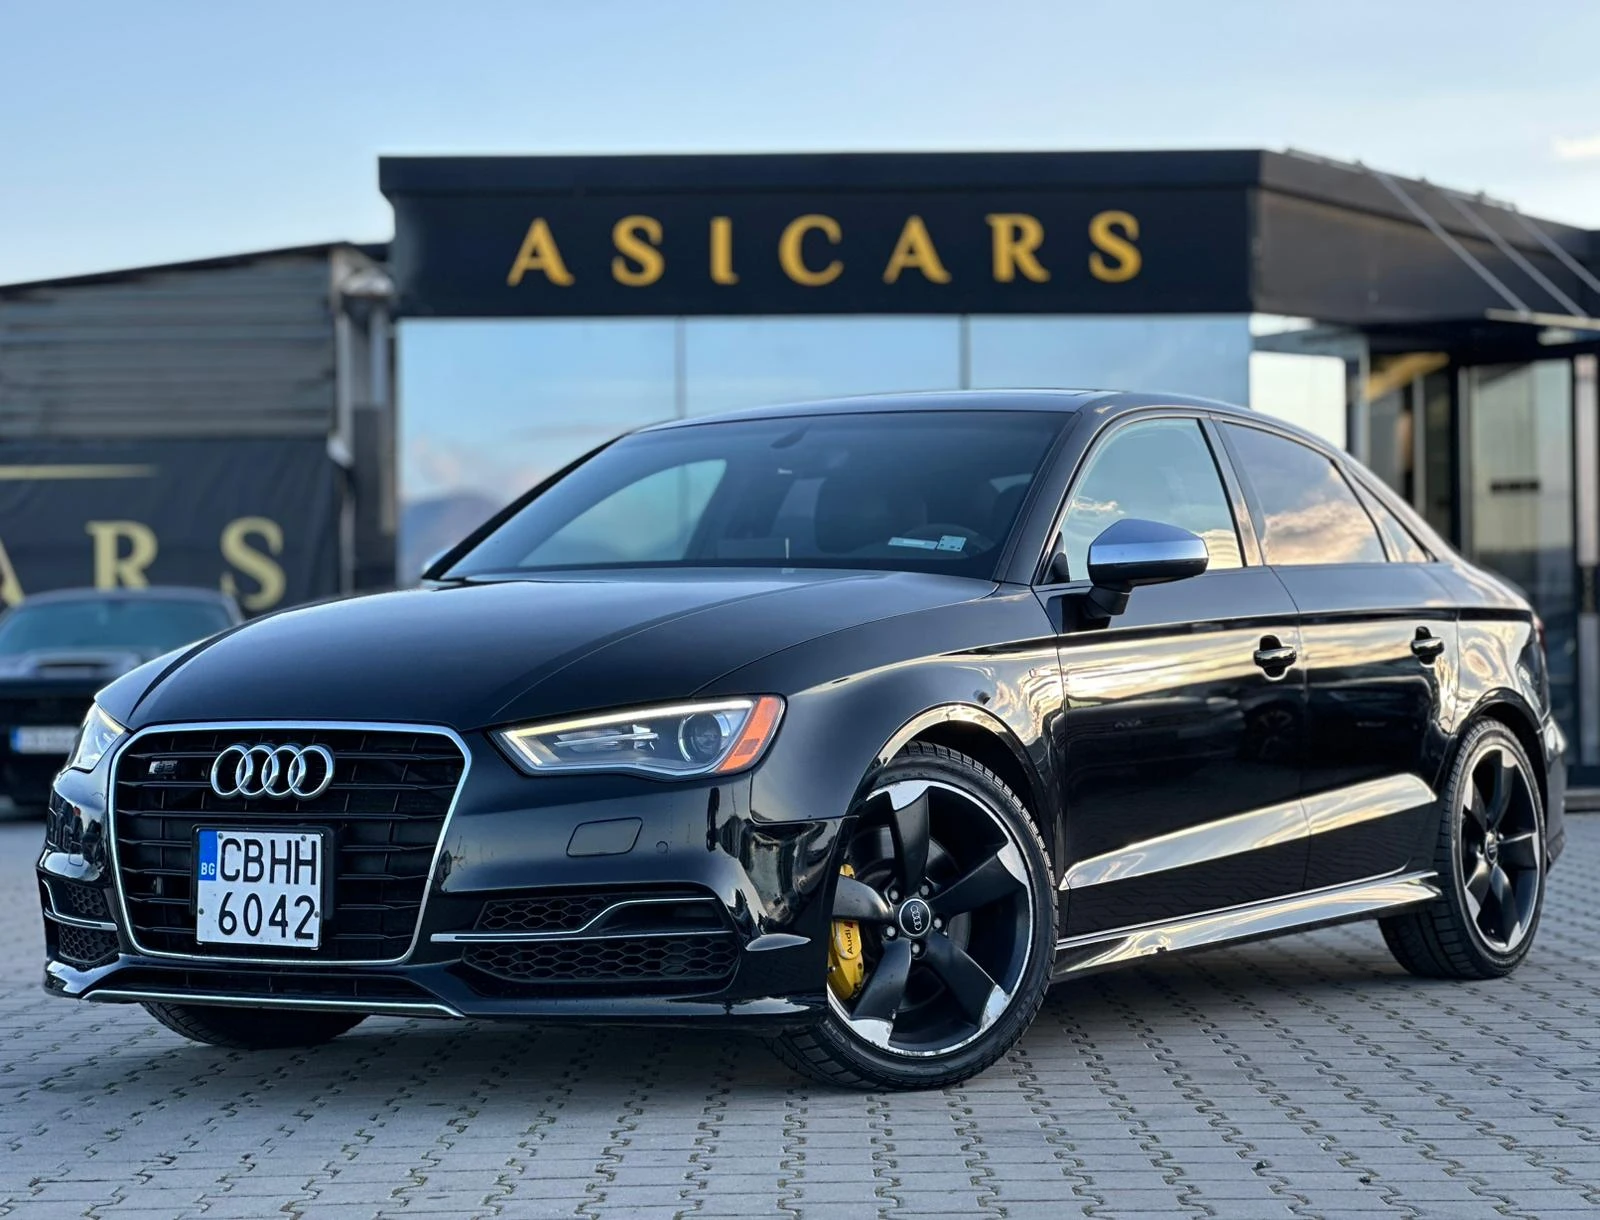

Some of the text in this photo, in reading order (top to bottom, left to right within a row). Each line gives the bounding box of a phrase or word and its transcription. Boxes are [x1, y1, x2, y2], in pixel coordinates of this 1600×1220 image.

[506, 210, 1143, 287] ASICARS
[200, 861, 216, 876] BG
[219, 837, 317, 886] CBHH
[218, 891, 315, 940] 6042
[845, 929, 854, 955] Audi
